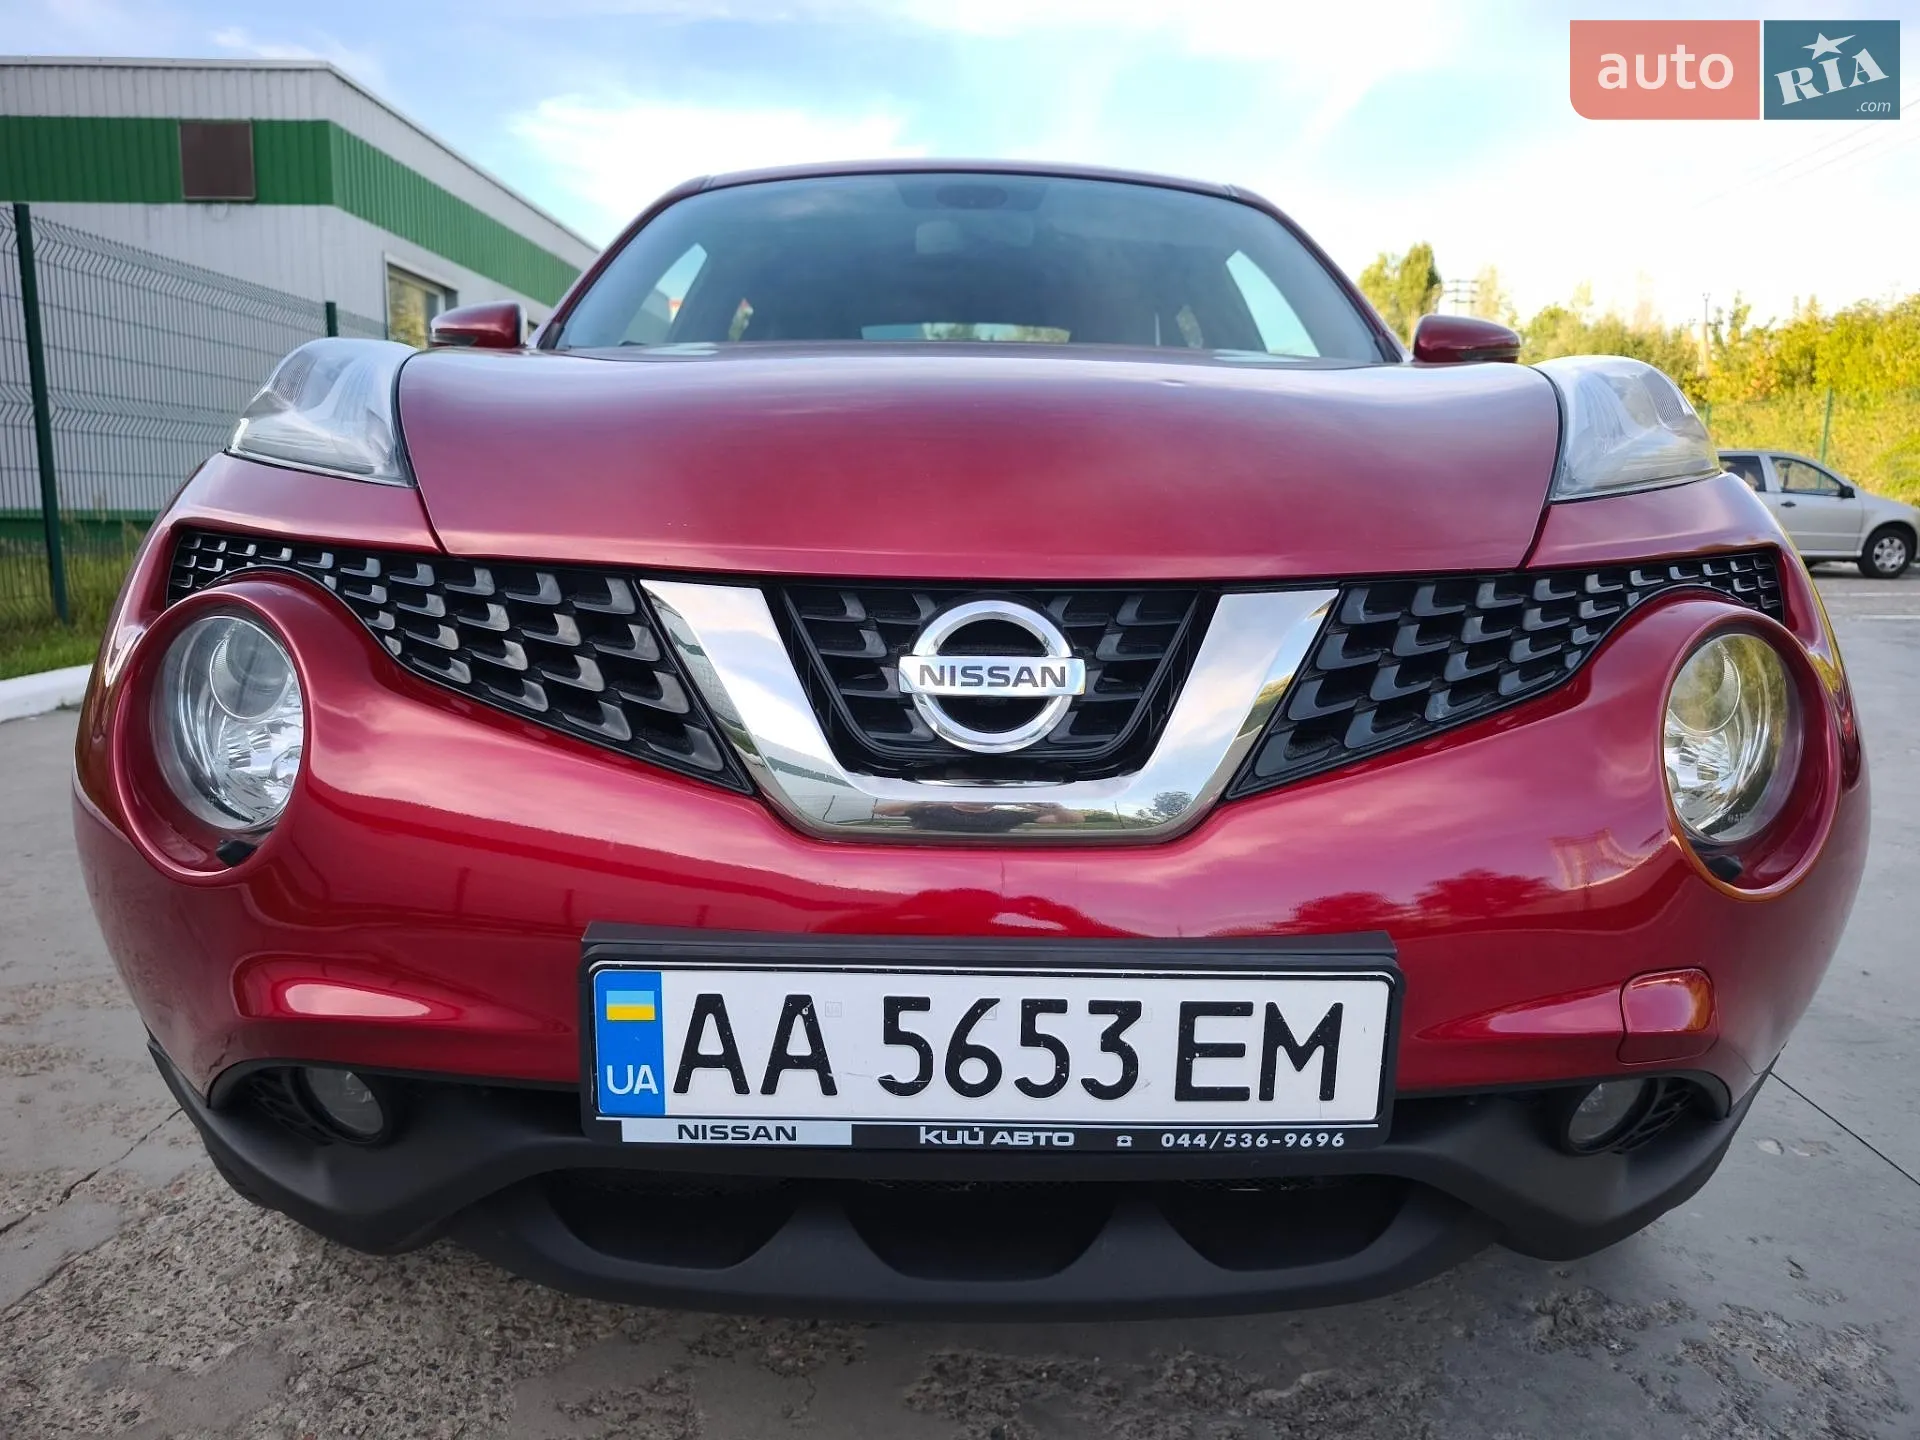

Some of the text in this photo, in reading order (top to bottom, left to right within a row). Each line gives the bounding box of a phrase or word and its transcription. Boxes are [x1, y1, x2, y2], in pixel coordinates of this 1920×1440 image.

[919, 664, 1066, 688] NISSAN
[673, 993, 1344, 1102] AA 5653 EM
[606, 1064, 659, 1095] UA
[677, 1124, 797, 1142] NISSAN
[1161, 1132, 1345, 1149] 044/536-9696
